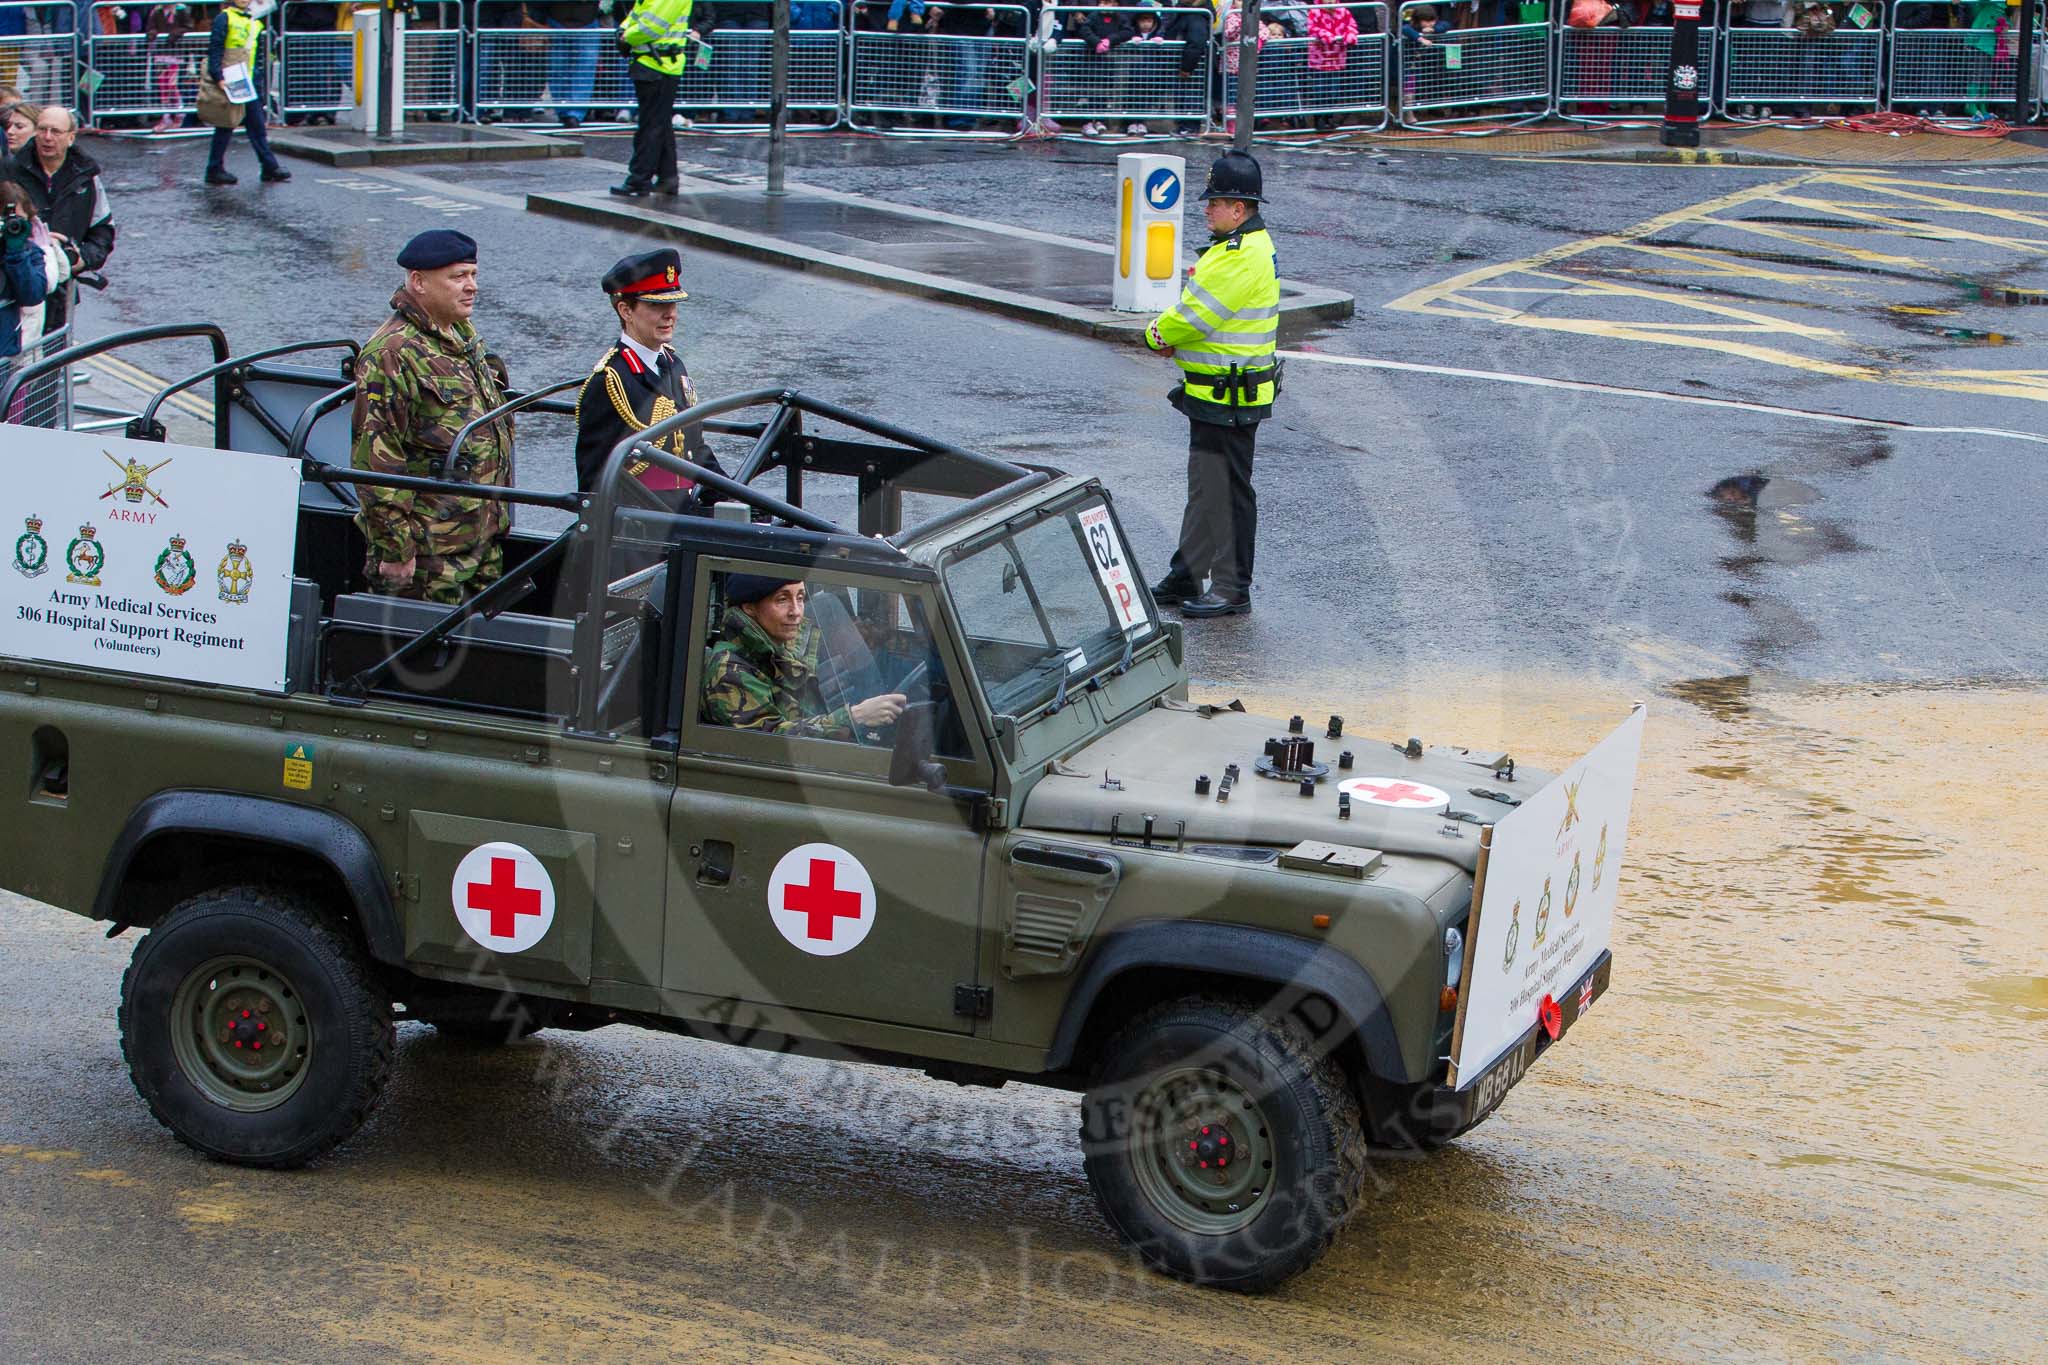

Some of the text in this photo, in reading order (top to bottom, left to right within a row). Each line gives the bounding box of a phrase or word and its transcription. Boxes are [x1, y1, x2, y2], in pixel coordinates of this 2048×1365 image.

[109, 508, 157, 525] ARMY
[1090, 523, 1119, 570] 62
[49, 589, 217, 624] Army Medical Services
[1115, 583, 1132, 622] P
[16, 606, 244, 650] 306 Hospital Support Regiment
[94, 637, 161, 658] (Volunteers)
